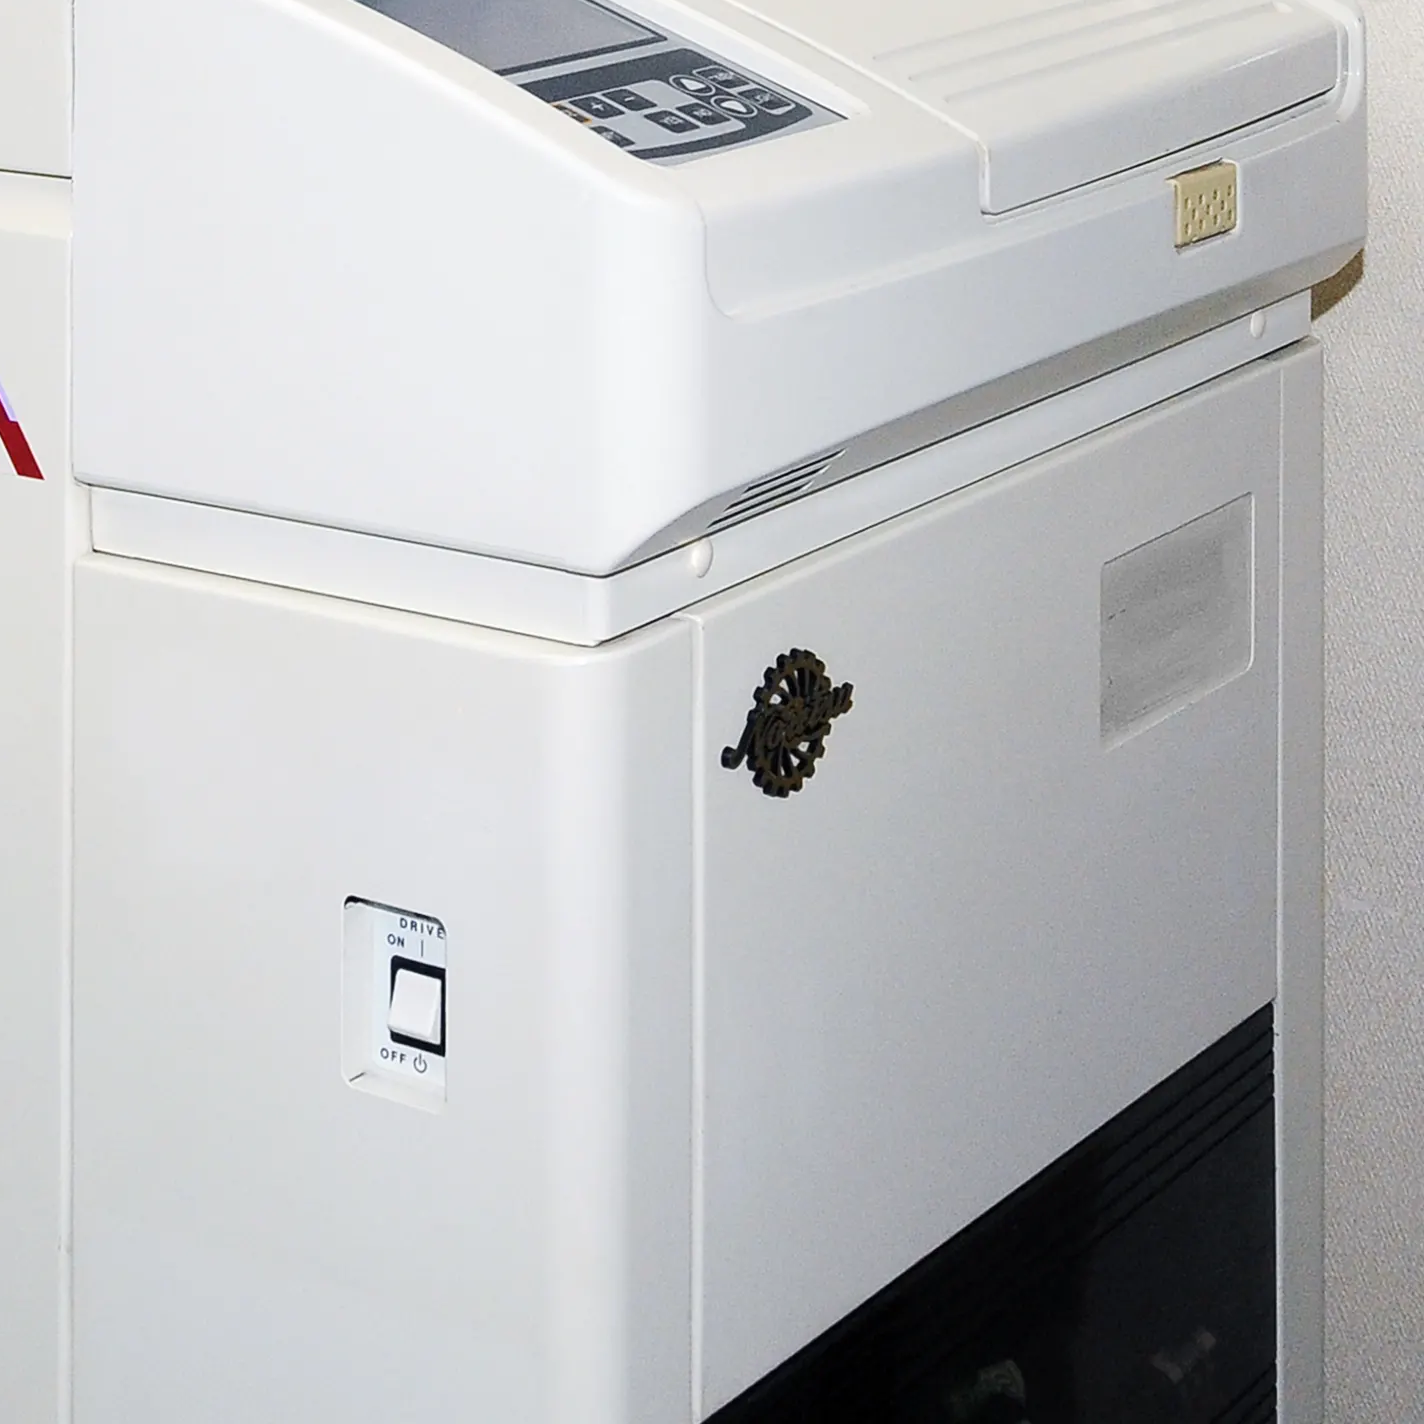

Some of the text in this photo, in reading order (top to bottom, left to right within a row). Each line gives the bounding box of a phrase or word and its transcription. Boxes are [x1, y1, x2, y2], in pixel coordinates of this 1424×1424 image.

[399, 917, 445, 940] DRIVE
[387, 933, 405, 948] ON
[379, 1047, 407, 1064] OFF
